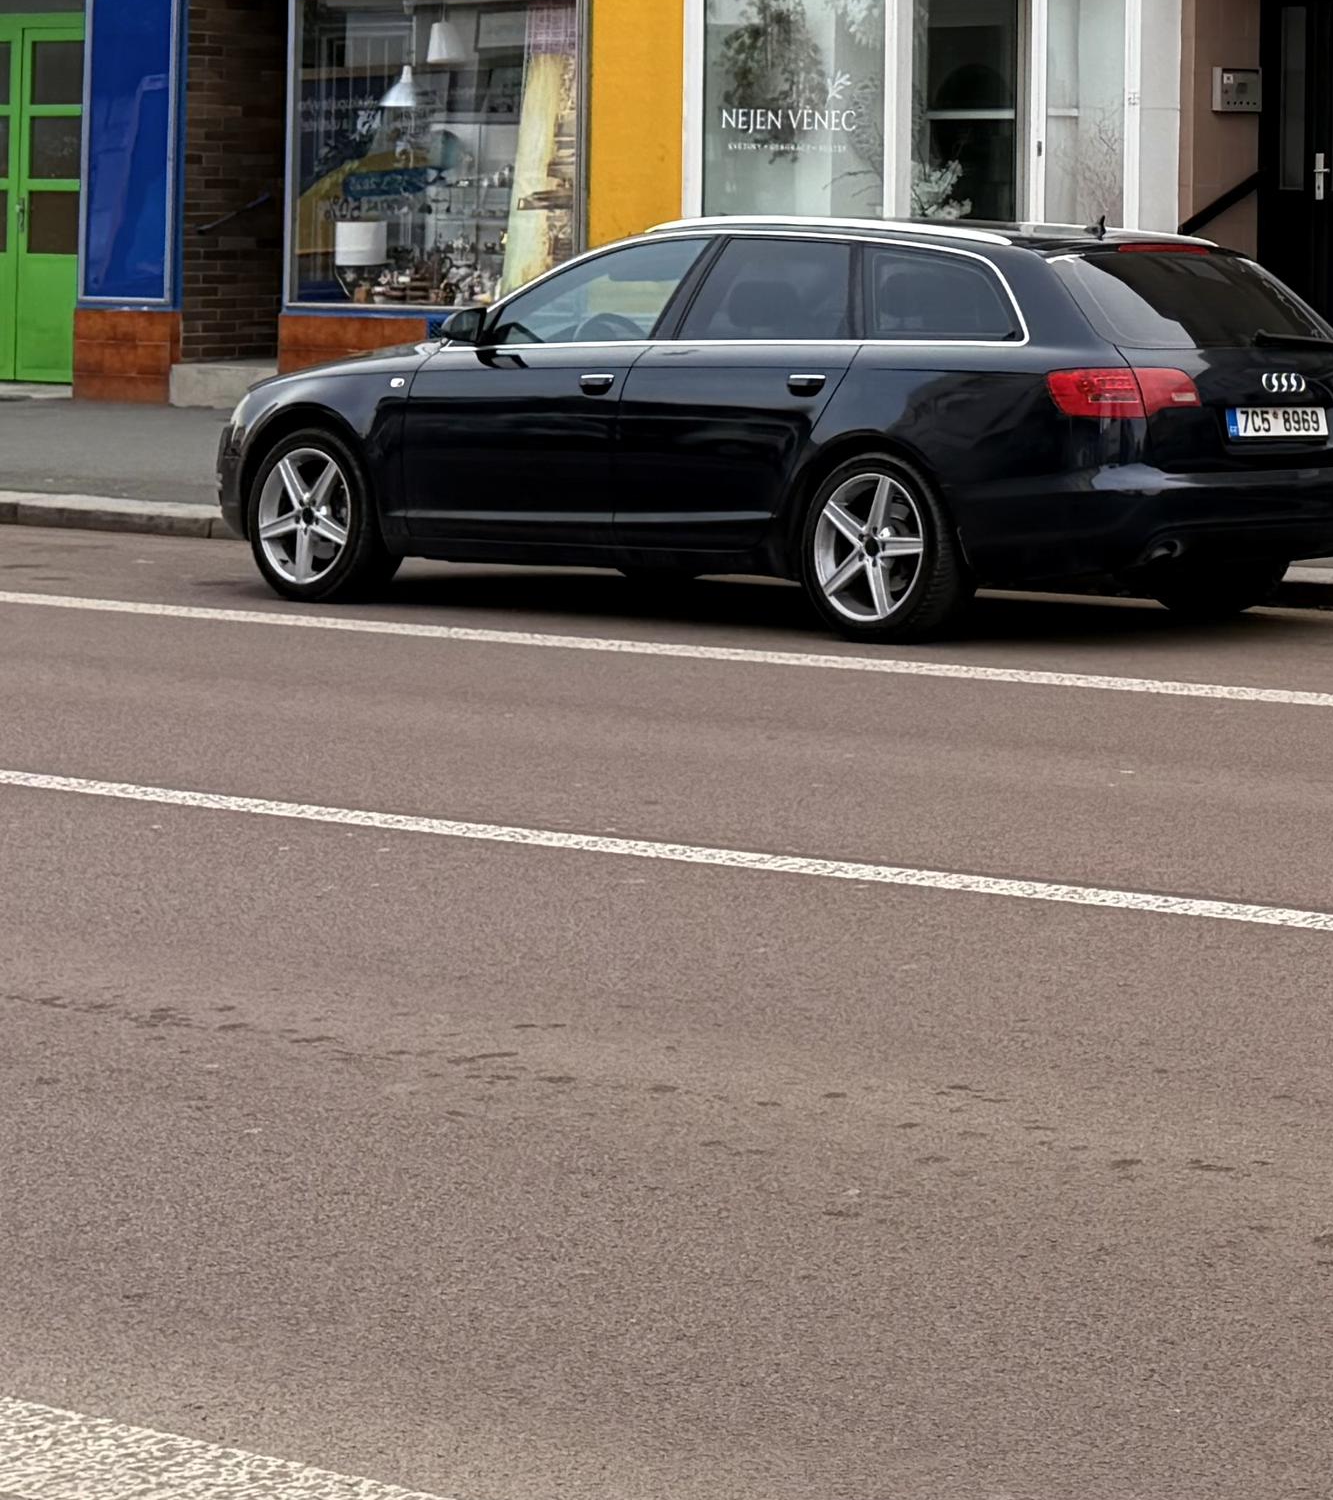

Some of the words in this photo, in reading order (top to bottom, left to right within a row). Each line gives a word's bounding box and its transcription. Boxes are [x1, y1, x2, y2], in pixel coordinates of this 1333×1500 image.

[721, 108, 782, 134] NEJEN
[788, 105, 857, 132] VĚNEC
[1241, 410, 1272, 433] 7C5
[1282, 410, 1320, 433] 8969
